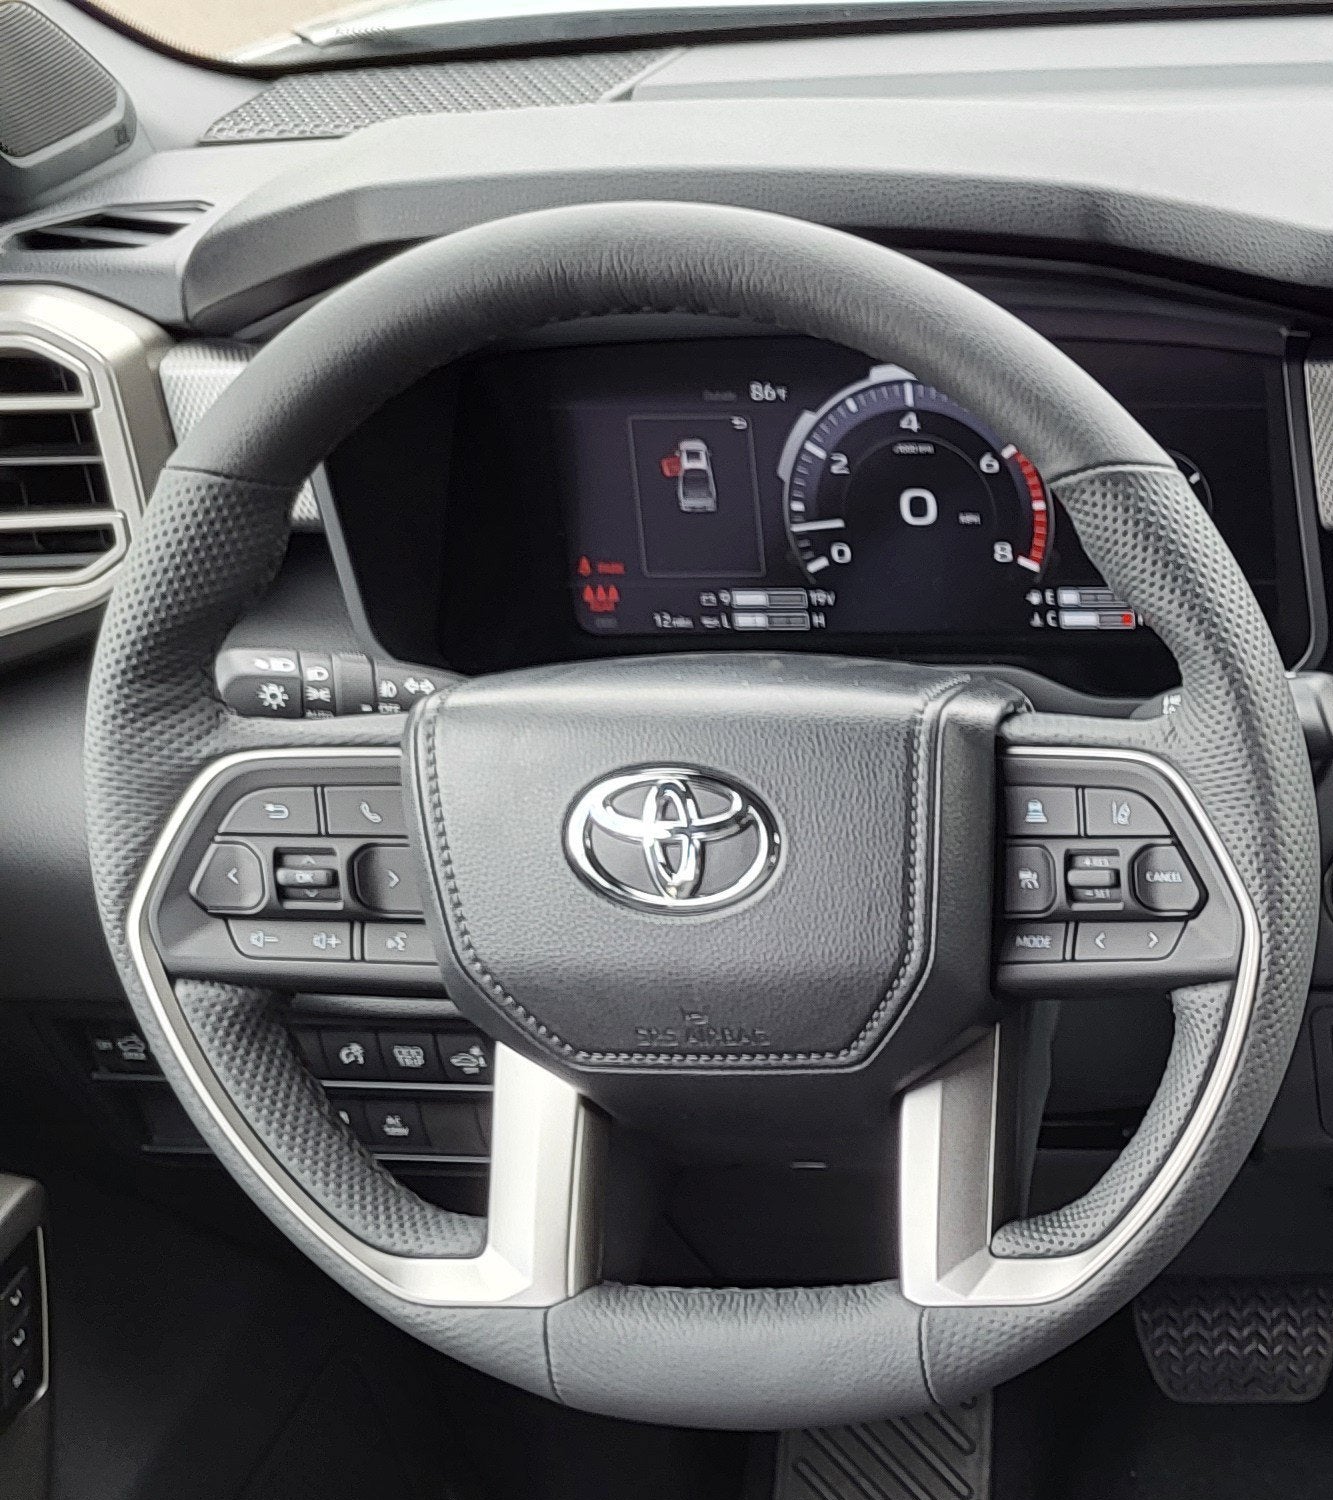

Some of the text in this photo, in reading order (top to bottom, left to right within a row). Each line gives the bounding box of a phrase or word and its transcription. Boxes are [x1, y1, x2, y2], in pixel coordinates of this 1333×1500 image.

[900, 411, 921, 433] 4
[830, 452, 851, 475] 2
[980, 452, 1000, 474] 6
[900, 488, 937, 526] 0
[831, 542, 851, 564] 0
[993, 541, 1014, 563] 8
[295, 872, 314, 884] OK
[1146, 871, 1183, 883] CANCEL
[1015, 934, 1052, 949] MODE
